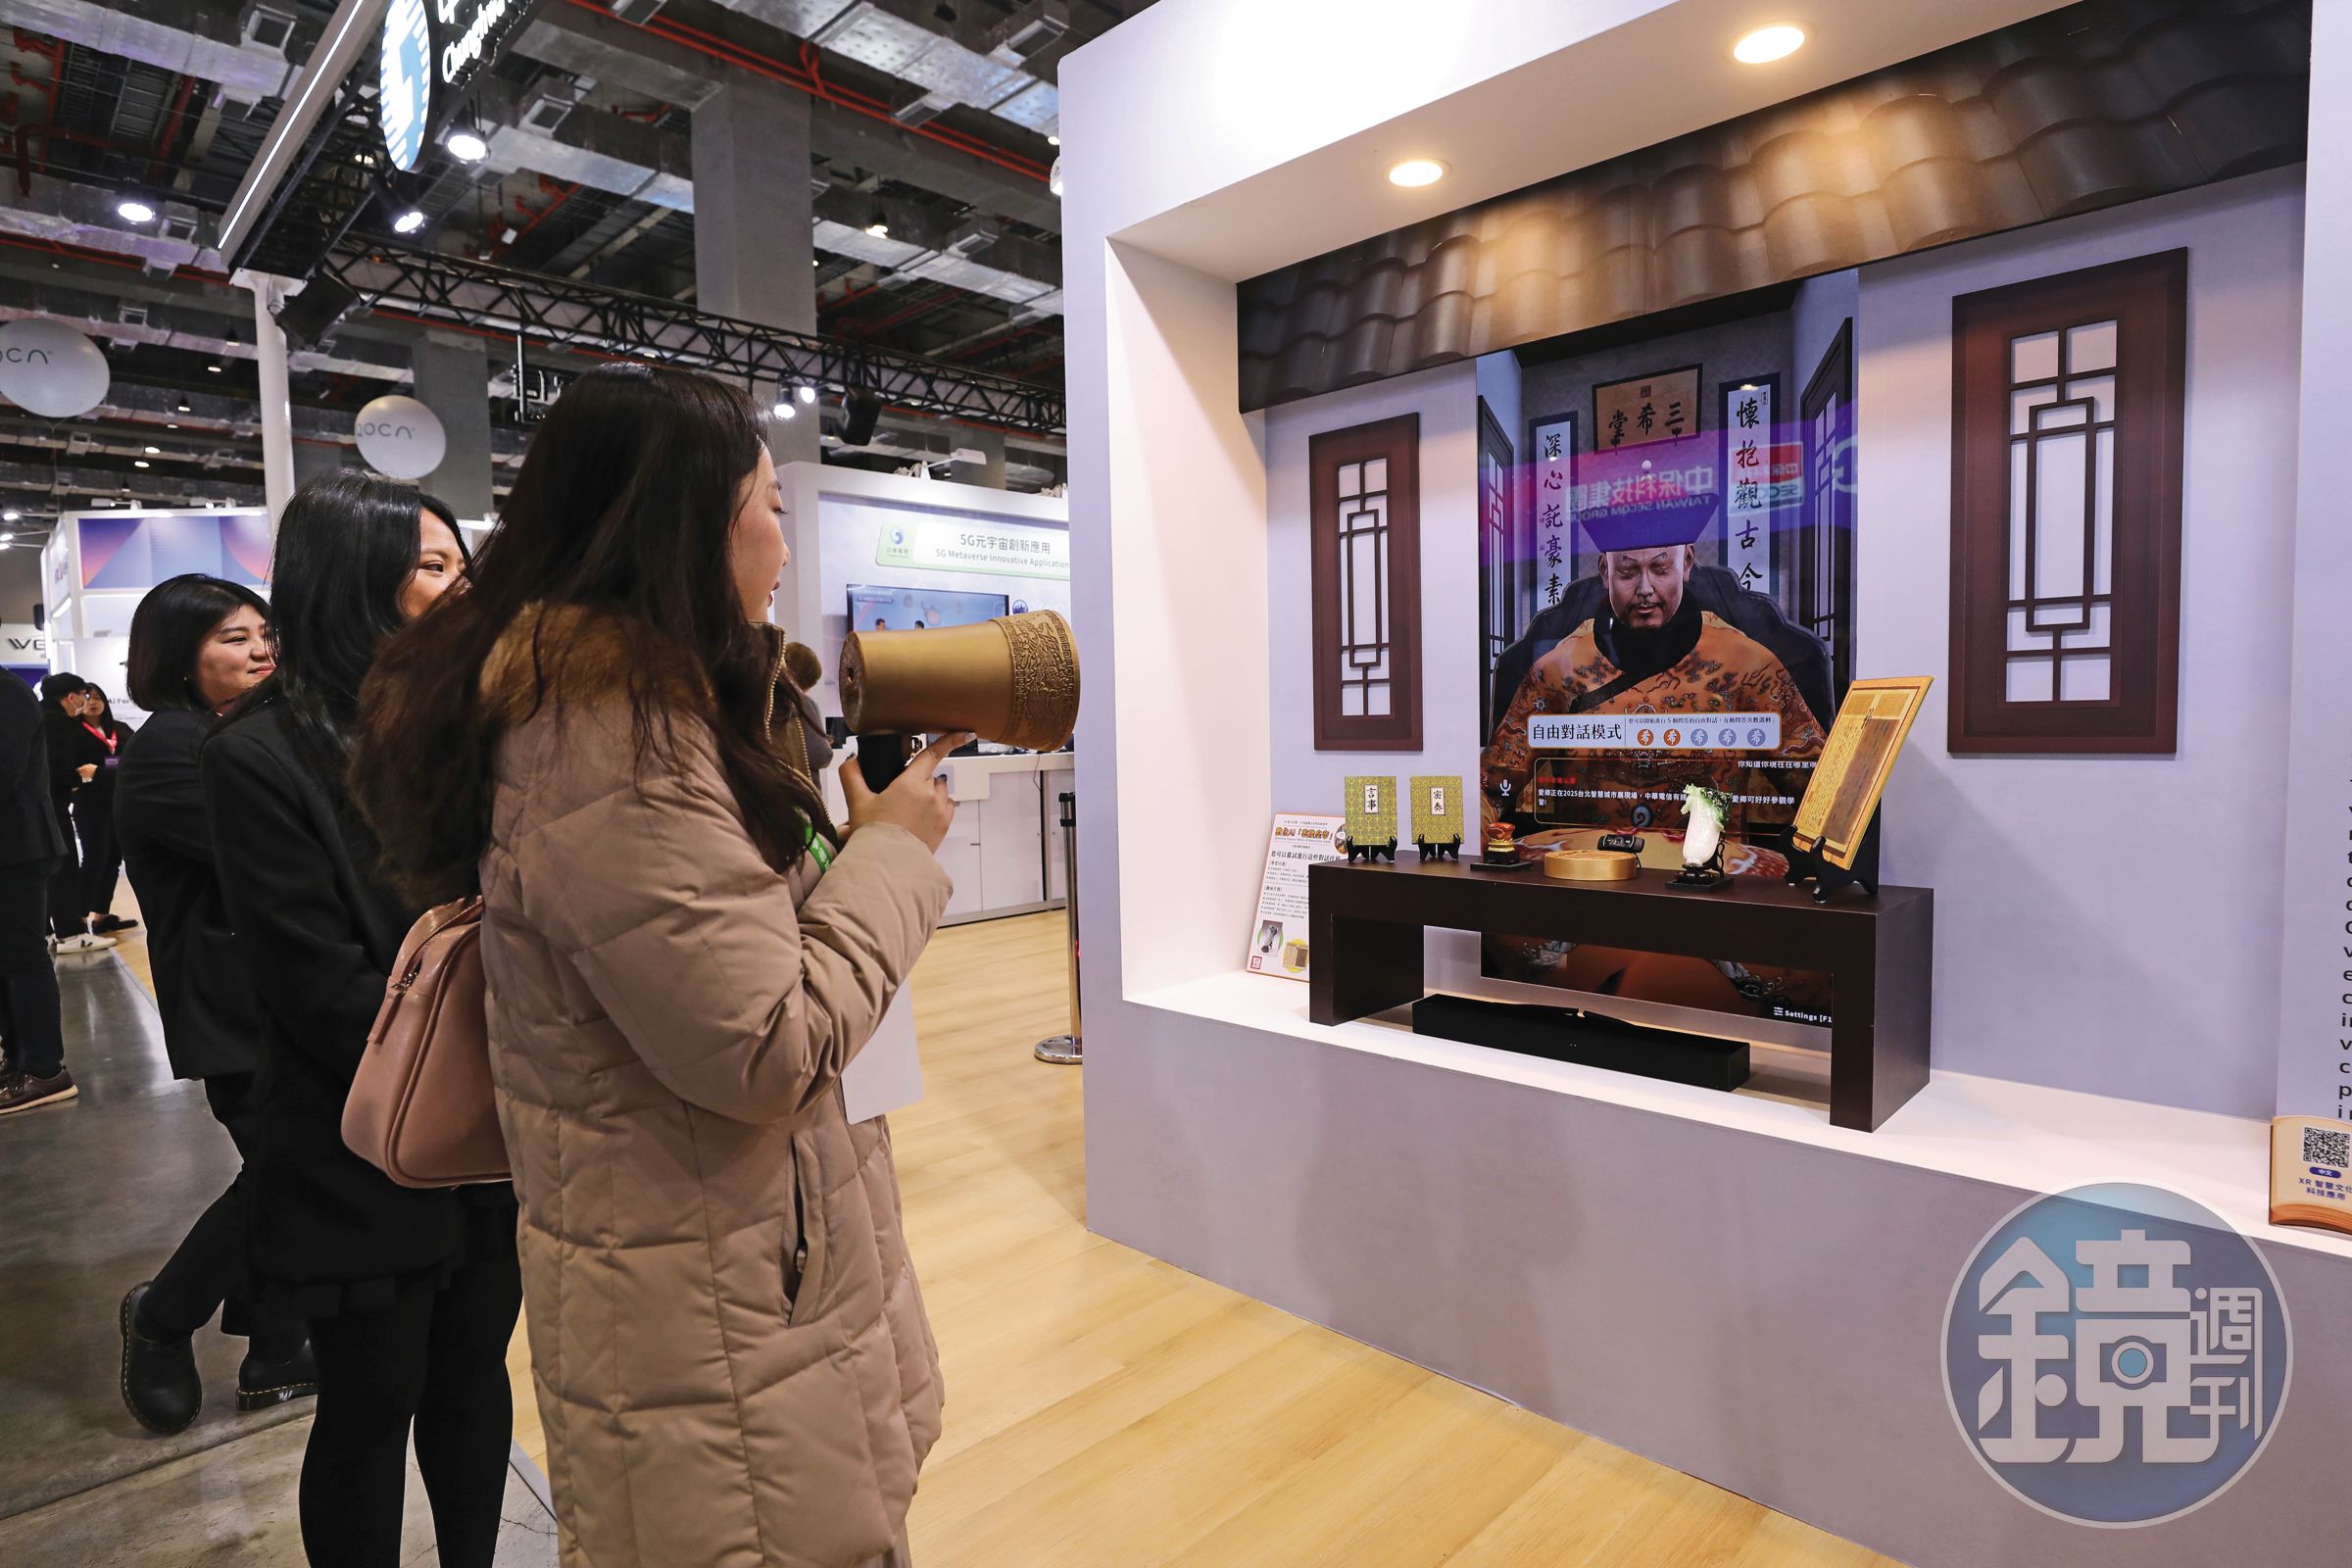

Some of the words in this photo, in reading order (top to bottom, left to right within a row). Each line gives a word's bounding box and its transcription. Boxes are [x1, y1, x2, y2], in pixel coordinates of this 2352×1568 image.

[960, 534, 1051, 555] 5G元宇宙創新應用
[936, 549, 947, 558] 5G
[949, 551, 988, 562] Metaverse
[990, 554, 1028, 565] Innovative
[1533, 723, 1622, 741] 自由對話模式
[1366, 787, 1377, 810] 言事
[1785, 1009, 1818, 1022] Settings
[2306, 1187, 2346, 1200] 科技應用
